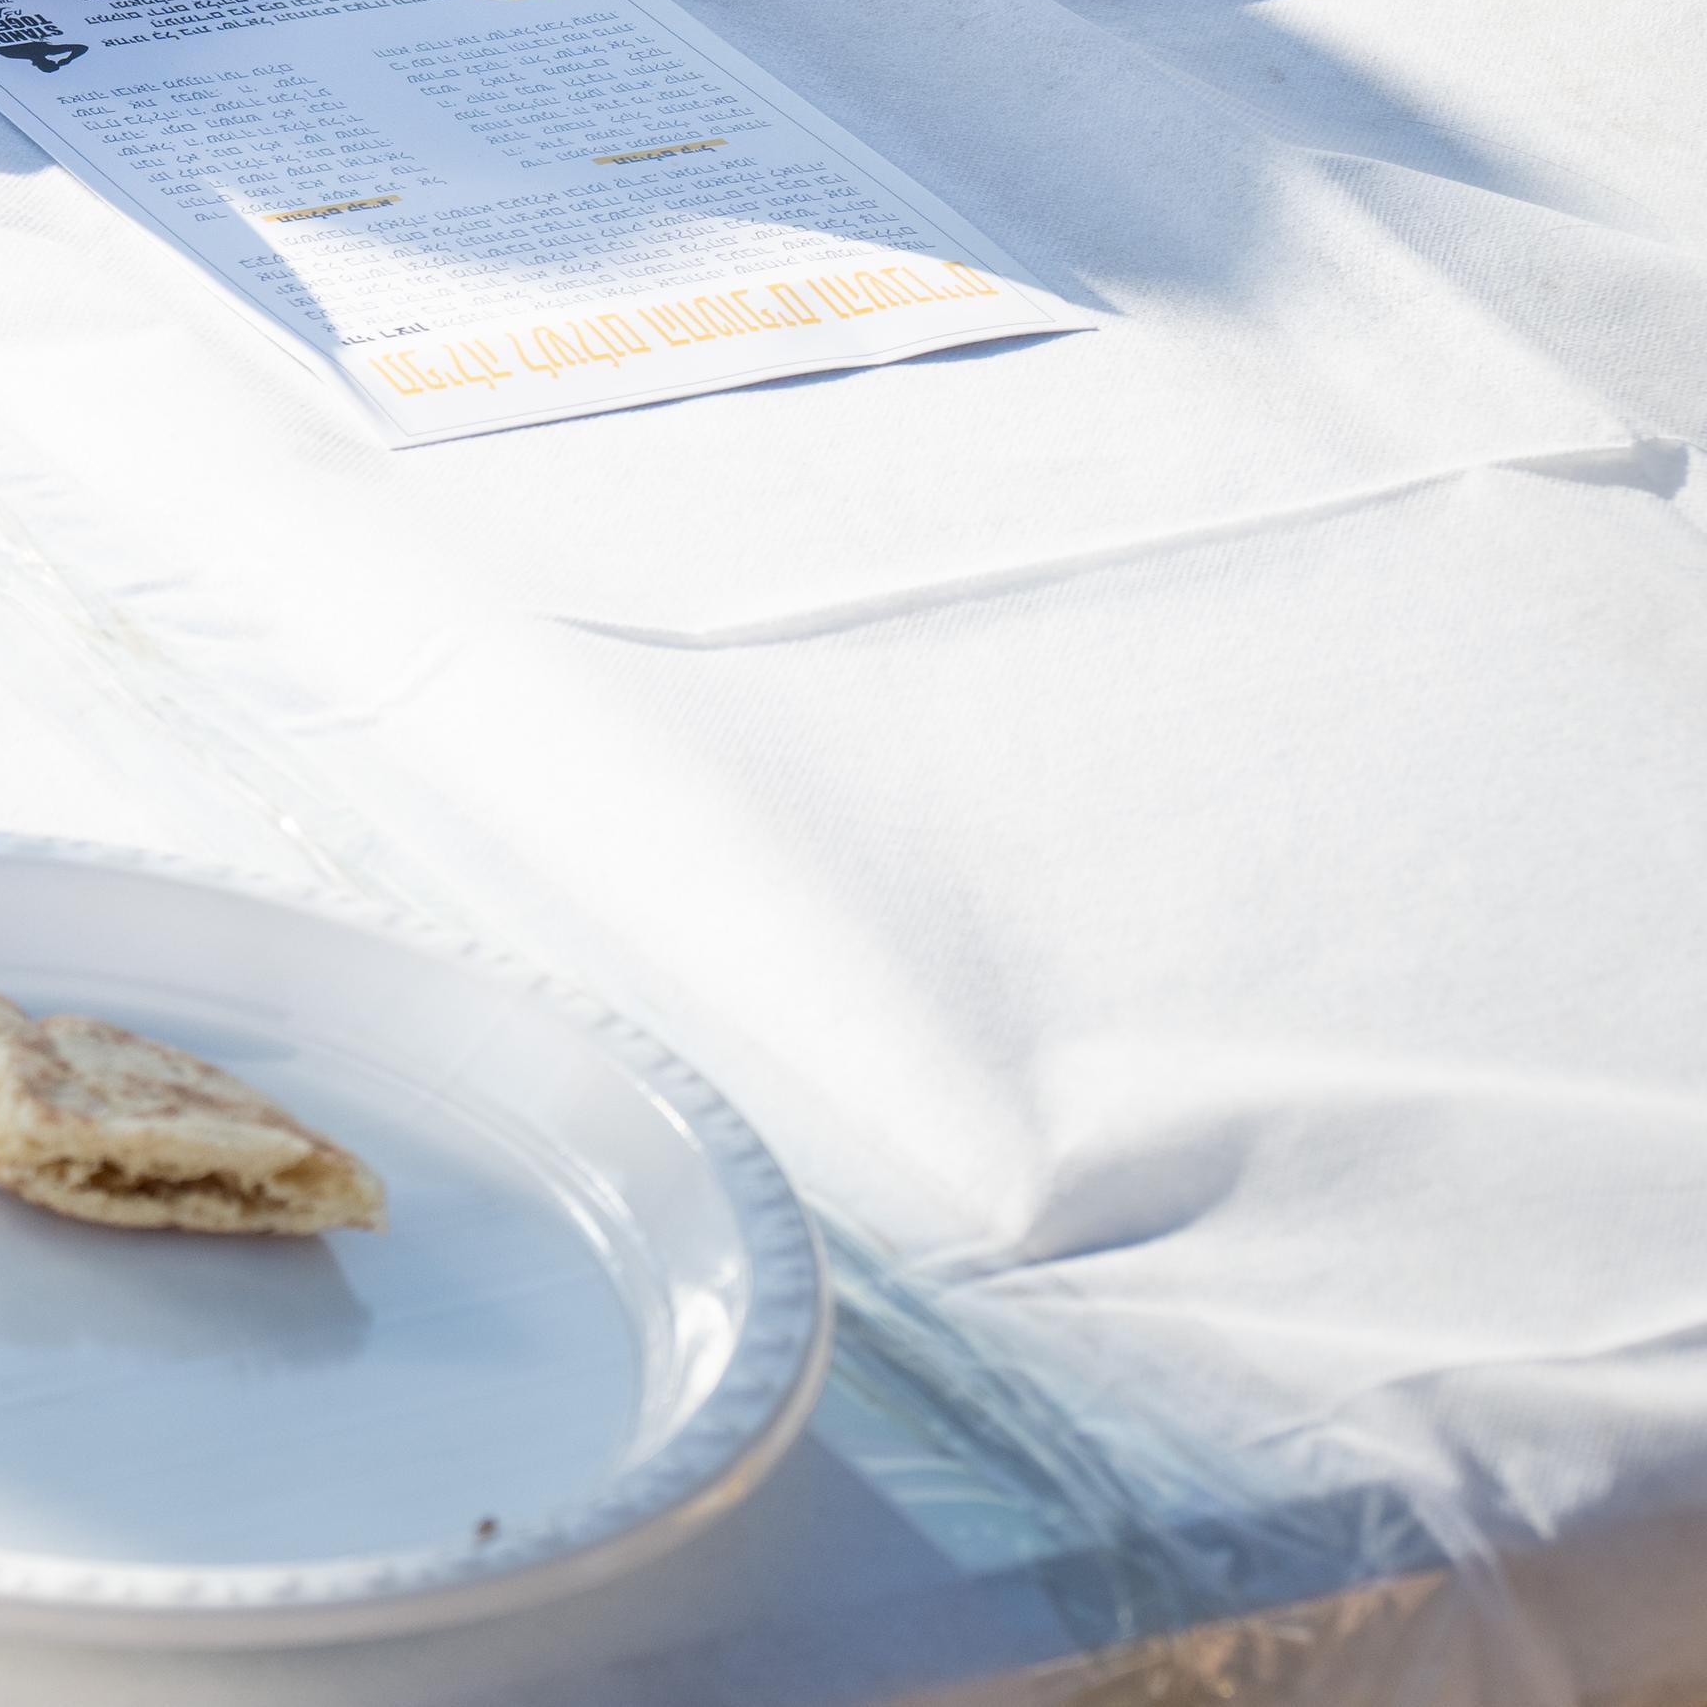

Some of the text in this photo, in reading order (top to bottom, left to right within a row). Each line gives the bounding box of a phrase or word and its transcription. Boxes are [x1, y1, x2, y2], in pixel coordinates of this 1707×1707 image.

[367, 261, 1000, 396] תפילה לשלום החטופים והשבויים
